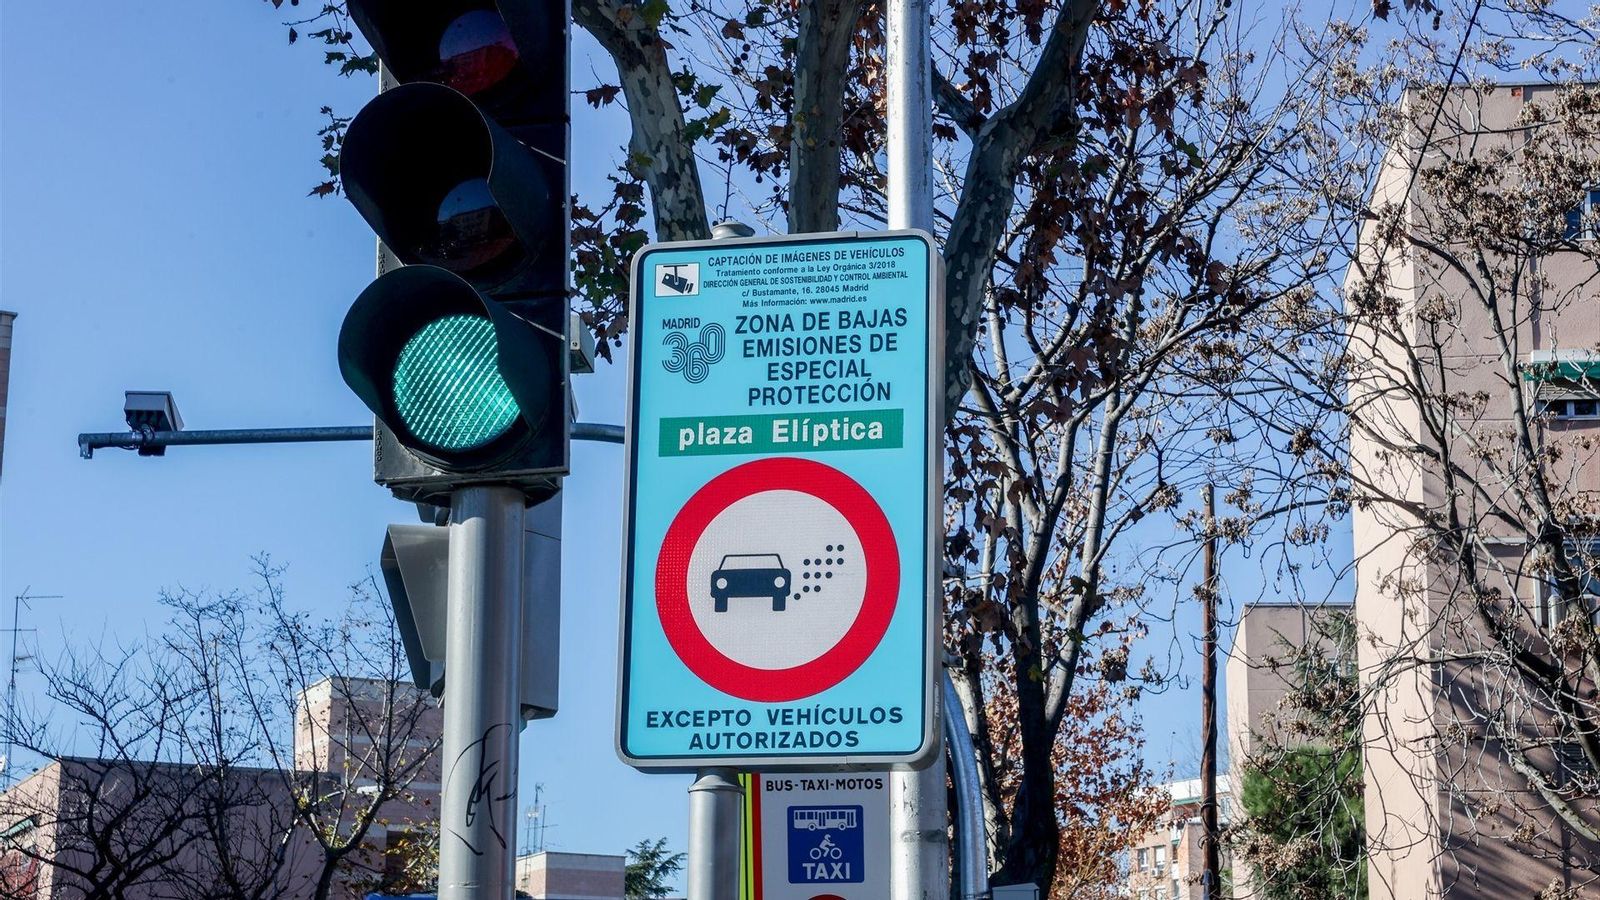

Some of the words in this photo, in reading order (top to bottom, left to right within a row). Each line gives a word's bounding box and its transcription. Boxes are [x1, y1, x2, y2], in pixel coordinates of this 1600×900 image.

[708, 253, 762, 267] CAPTACIÓN
[765, 254, 778, 264] DE
[781, 250, 831, 263] IMÁGENES
[834, 250, 847, 260] DE
[850, 247, 905, 259] VEHÍCULOS
[716, 269, 760, 277] Tratamiento
[763, 267, 798, 275] conforme
[817, 264, 830, 273] Ley
[833, 262, 866, 272] Orgánica
[869, 261, 896, 269] 3/2018
[703, 279, 738, 288] DIRECCIÓN
[740, 278, 768, 287] GENERAL
[770, 277, 779, 285] DE
[780, 274, 832, 284] SOSTENIBILIDAD
[833, 274, 838, 282] Y
[840, 272, 871, 282] CONTROL
[872, 271, 909, 280] AMBIENTAL
[742, 289, 750, 298] c/
[816, 285, 840, 294] 28045
[842, 284, 869, 293] Madrid
[742, 300, 758, 308] Más
[761, 298, 807, 307] Información:
[810, 295, 867, 305] www.madrid.es
[662, 317, 701, 330] MADRID
[734, 313, 795, 334] ZONA
[802, 311, 831, 331] DE
[839, 308, 908, 329] BAJAS
[662, 323, 726, 384] 360
[743, 333, 862, 358] EMISIONES
[870, 333, 898, 352] DE
[767, 358, 872, 382] ESPECIAL
[748, 378, 891, 407] PROTECCIÓN
[679, 422, 753, 451] plaza
[772, 417, 883, 447] Elíptica
[646, 709, 752, 728] EXCEPTO
[767, 704, 904, 726] VEHÍCULOS
[689, 730, 859, 750] AUTORIZADOS
[766, 778, 883, 792] BUS-TAXI-MOTOS
[802, 862, 851, 880] TAXI
